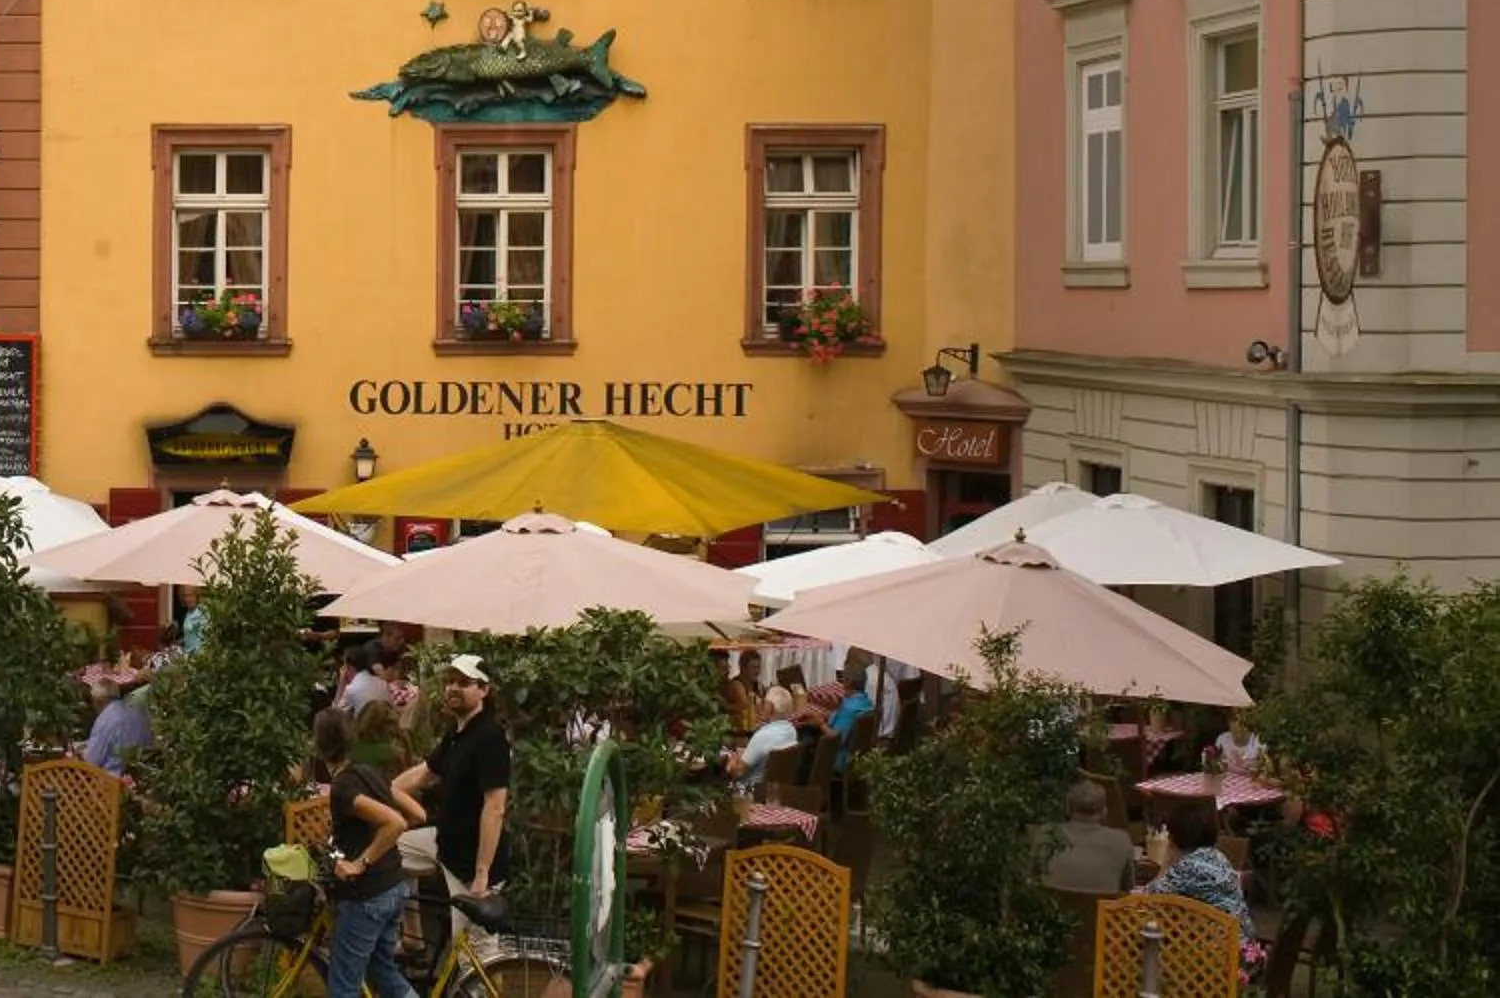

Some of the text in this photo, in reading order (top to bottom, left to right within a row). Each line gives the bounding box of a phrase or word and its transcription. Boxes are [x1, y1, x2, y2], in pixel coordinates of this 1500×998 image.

[349, 379, 753, 417] GOLDENER HECHT
[916, 426, 995, 458] Hotel
